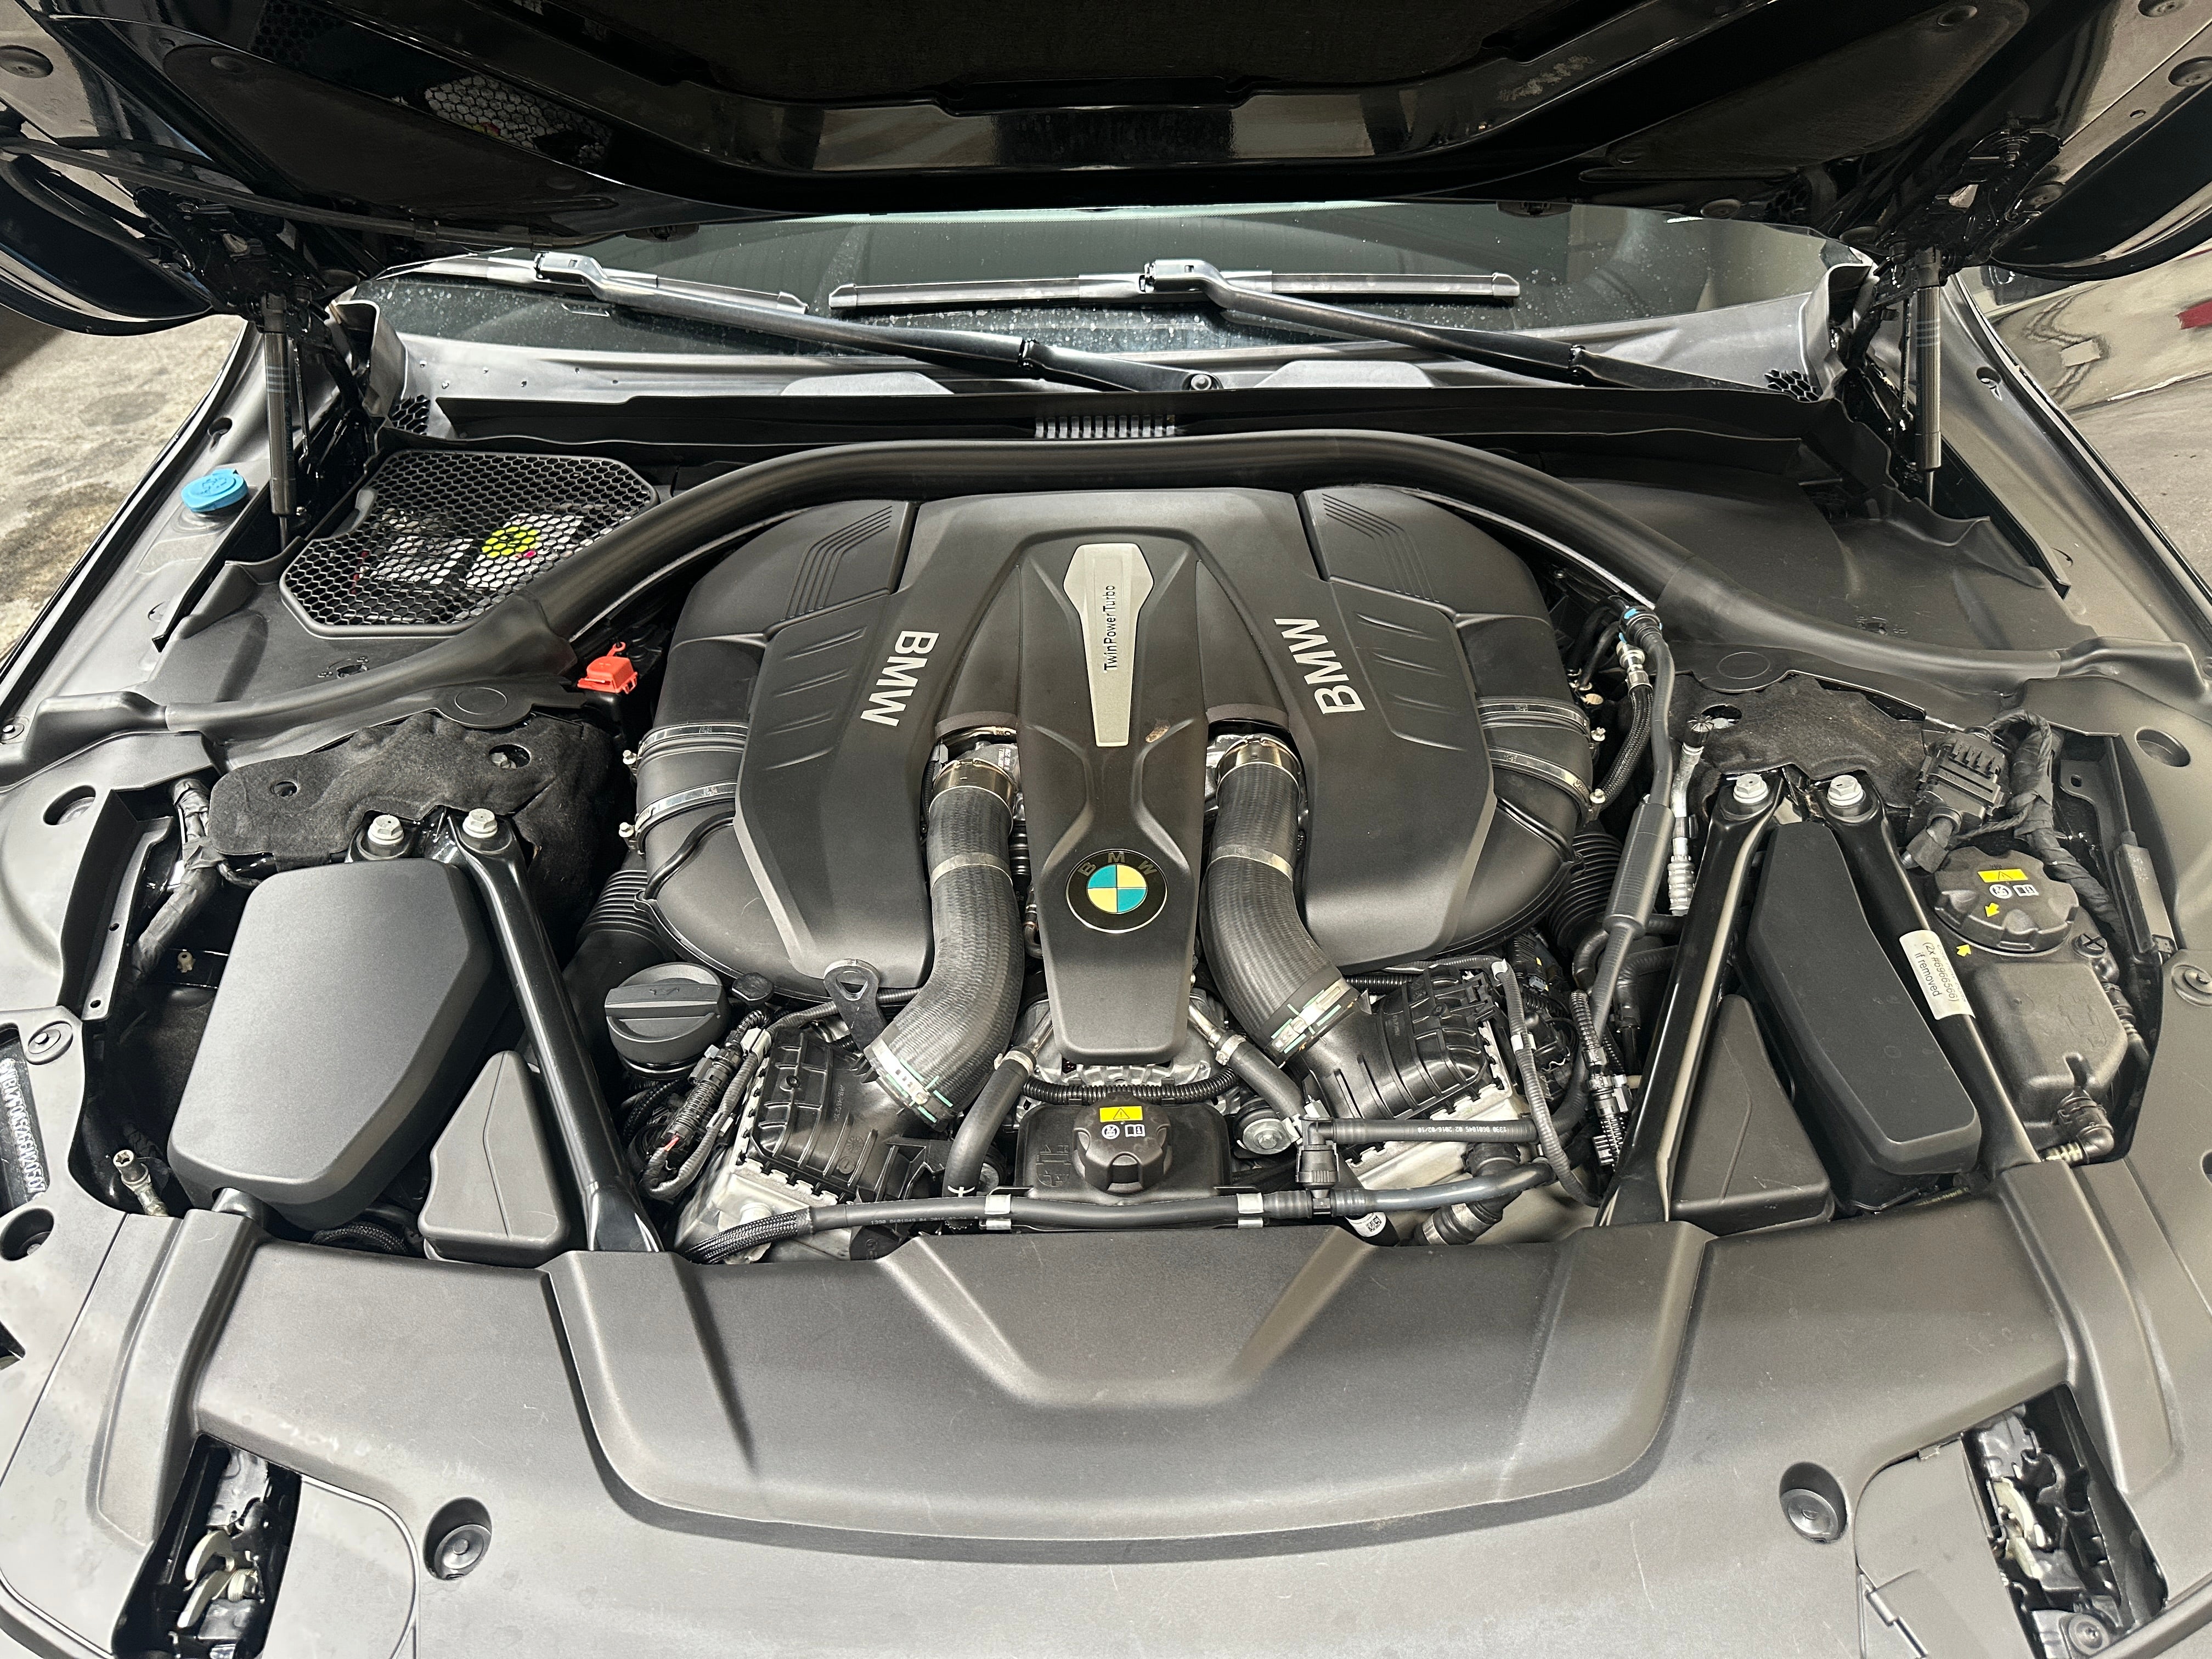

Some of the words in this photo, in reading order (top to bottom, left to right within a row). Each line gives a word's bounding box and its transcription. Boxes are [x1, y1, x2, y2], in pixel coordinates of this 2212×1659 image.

[860, 630, 939, 727] BMW
[1274, 618, 1365, 714] BMW
[1077, 851, 1158, 877] BMW
[1918, 958, 1943, 997] removed
[1922, 942, 1936, 955] (2x
[1931, 956, 1960, 1002] #6966566)
